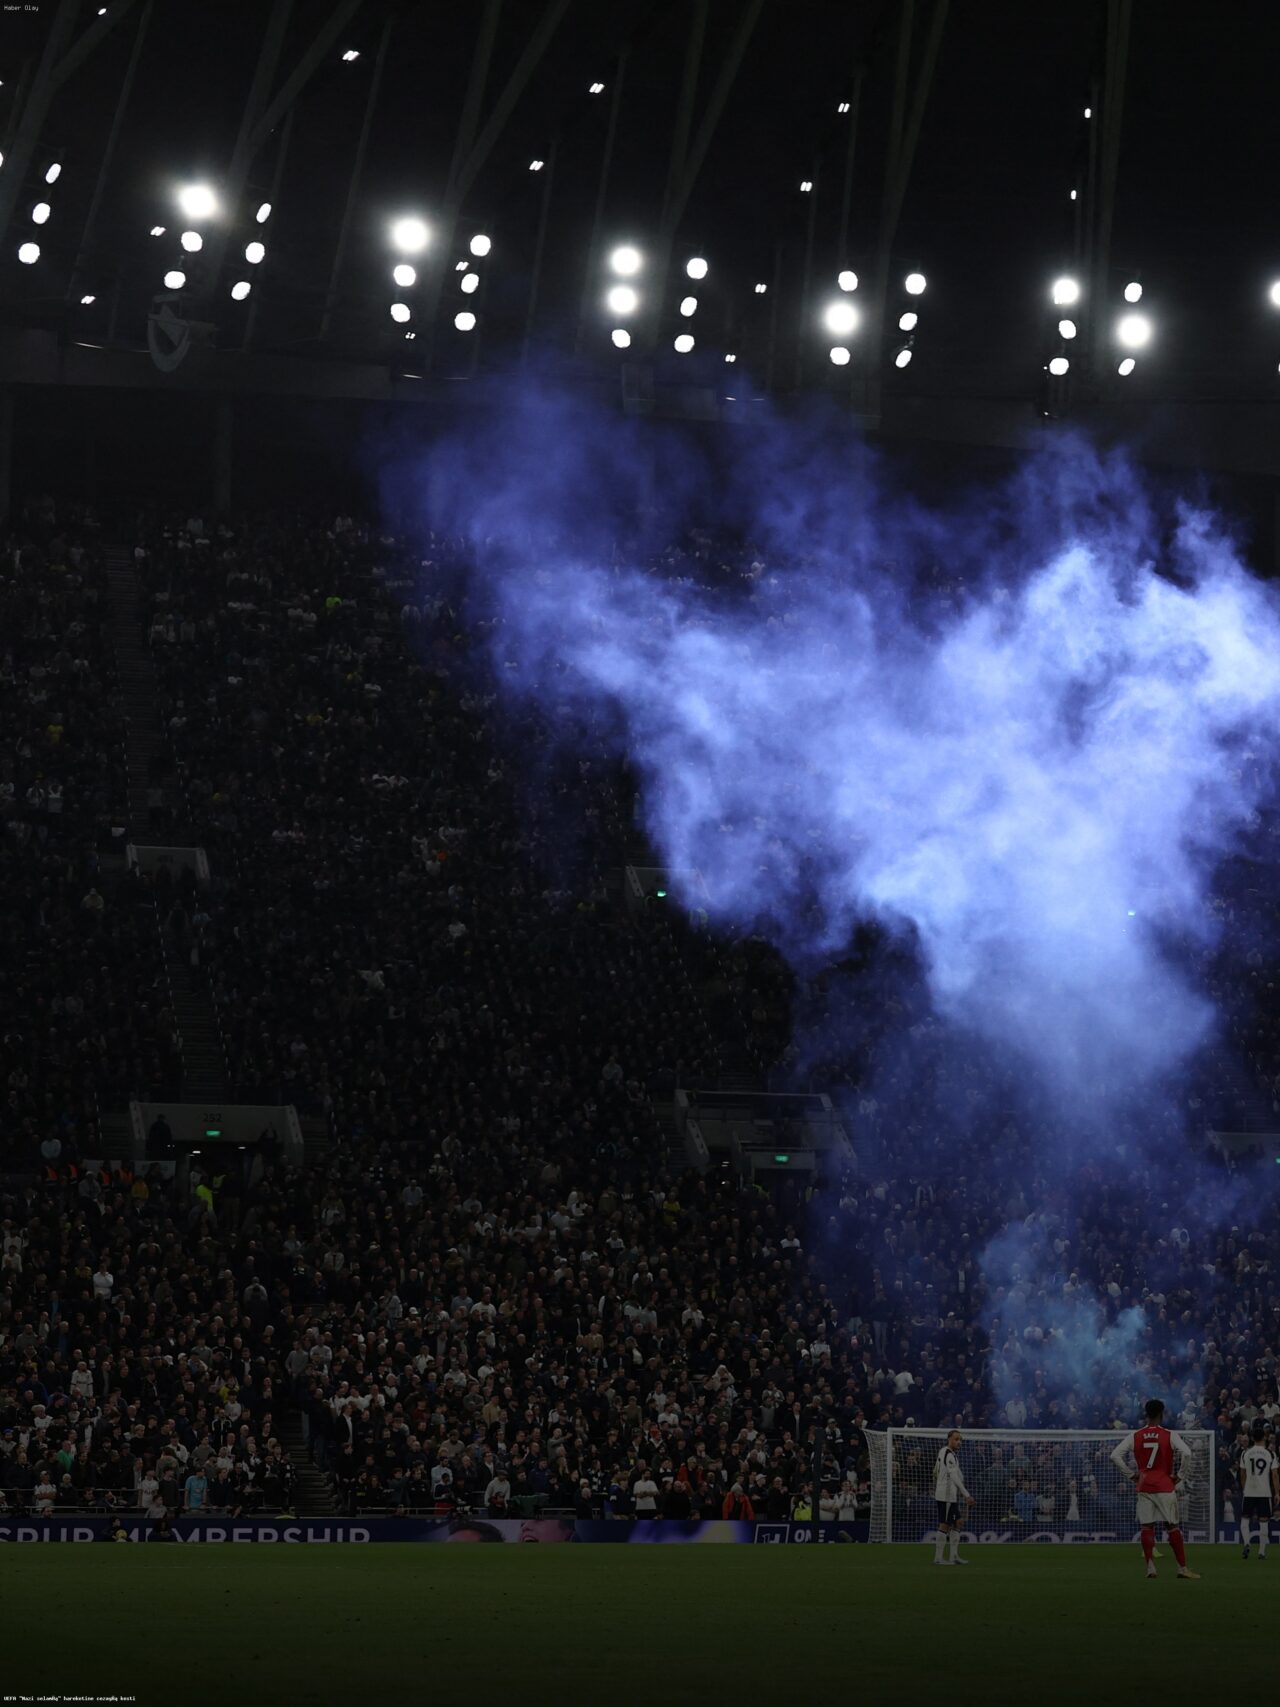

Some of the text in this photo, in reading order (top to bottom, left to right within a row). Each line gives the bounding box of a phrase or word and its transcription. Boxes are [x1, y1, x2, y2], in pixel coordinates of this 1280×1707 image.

[1142, 1431, 1159, 1440] SAKA
[1143, 1441, 1159, 1469] 7
[1249, 1457, 1267, 1476] 19
